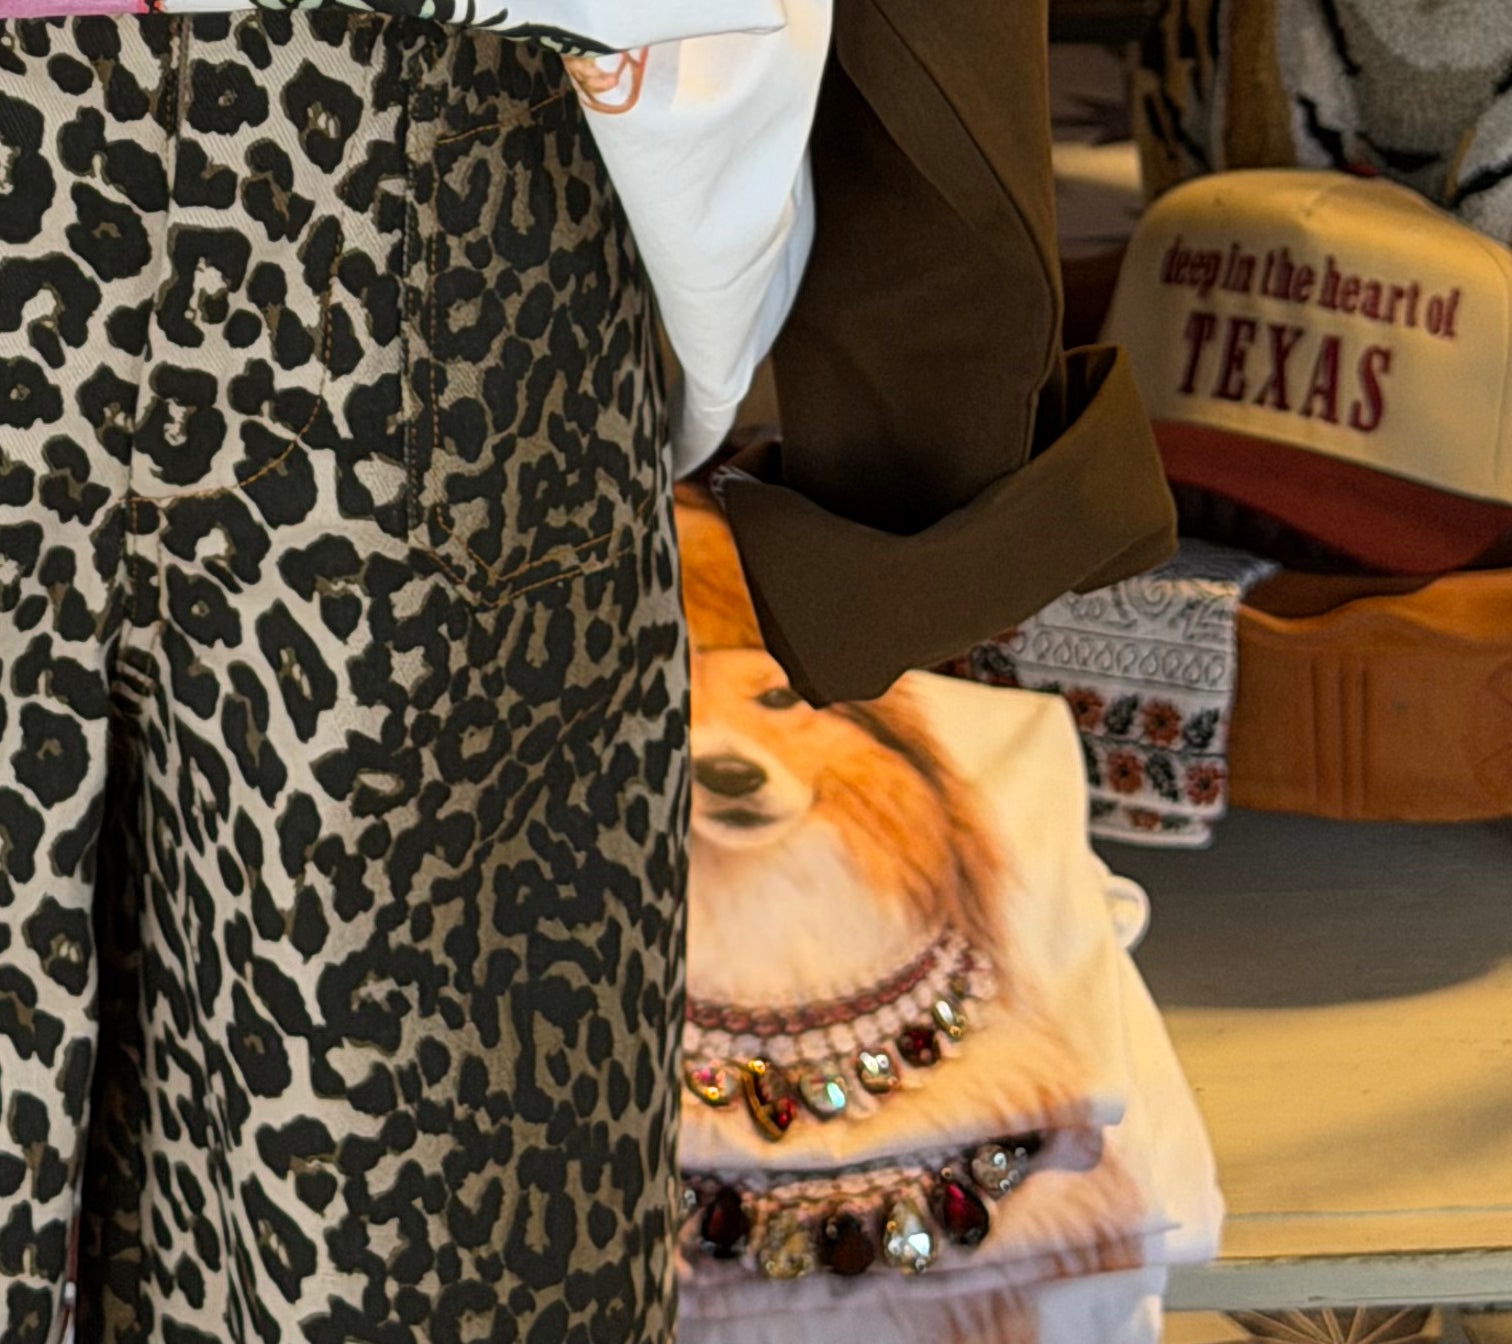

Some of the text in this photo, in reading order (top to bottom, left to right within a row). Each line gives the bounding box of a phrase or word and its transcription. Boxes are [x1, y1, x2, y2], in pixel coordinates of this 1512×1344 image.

[1160, 234, 1462, 338] deep in the heart of
[1177, 310, 1393, 433] TEXAS
